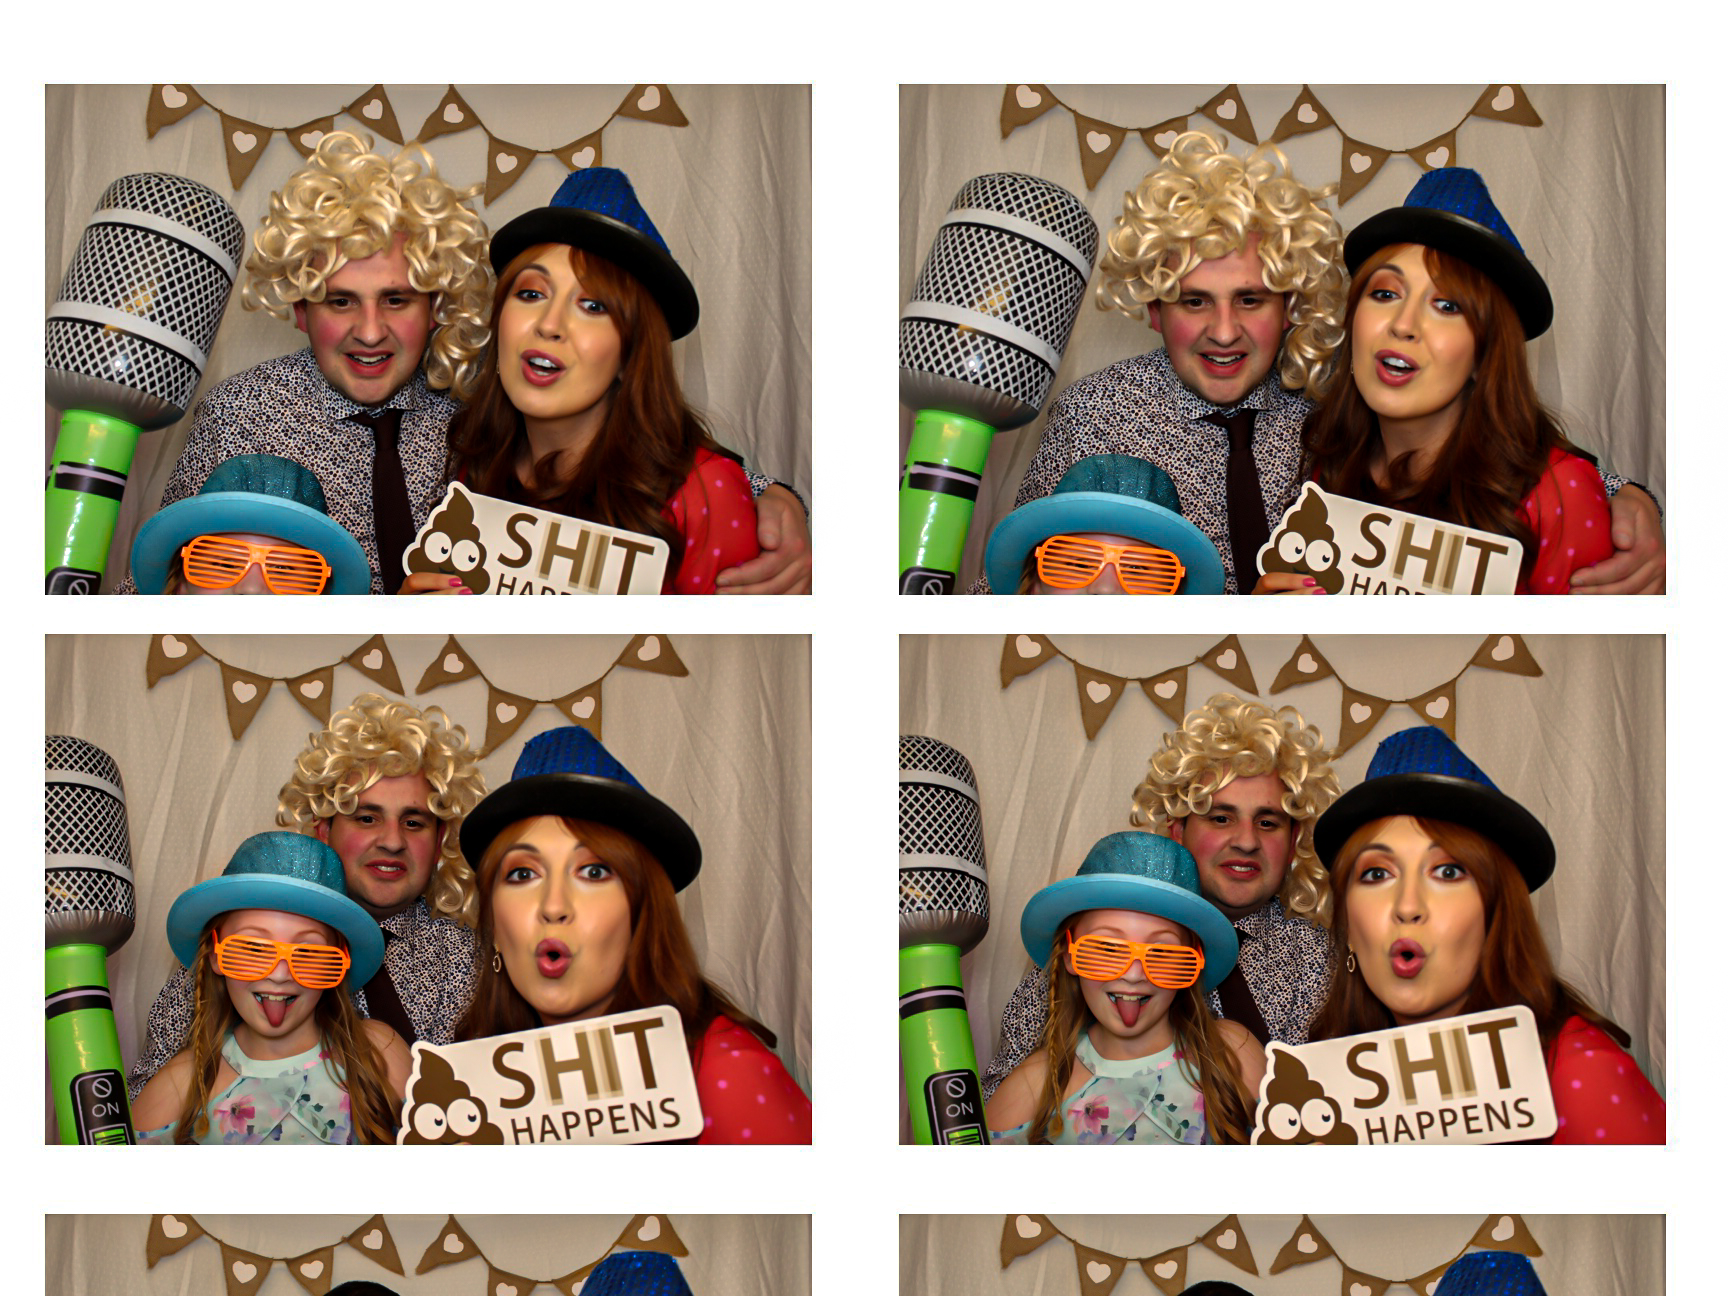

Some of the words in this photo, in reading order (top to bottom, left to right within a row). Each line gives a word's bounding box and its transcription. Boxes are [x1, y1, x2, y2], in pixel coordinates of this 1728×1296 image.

[497, 512, 655, 595] SHIT
[1351, 512, 1509, 595] SHIT
[492, 1017, 664, 1109] SHIT
[1346, 1017, 1518, 1109] SHIT
[92, 1102, 119, 1117] ON
[511, 1097, 680, 1145] HAPPENS
[946, 1102, 973, 1117] ON
[1365, 1097, 1534, 1145] HAPPENS
